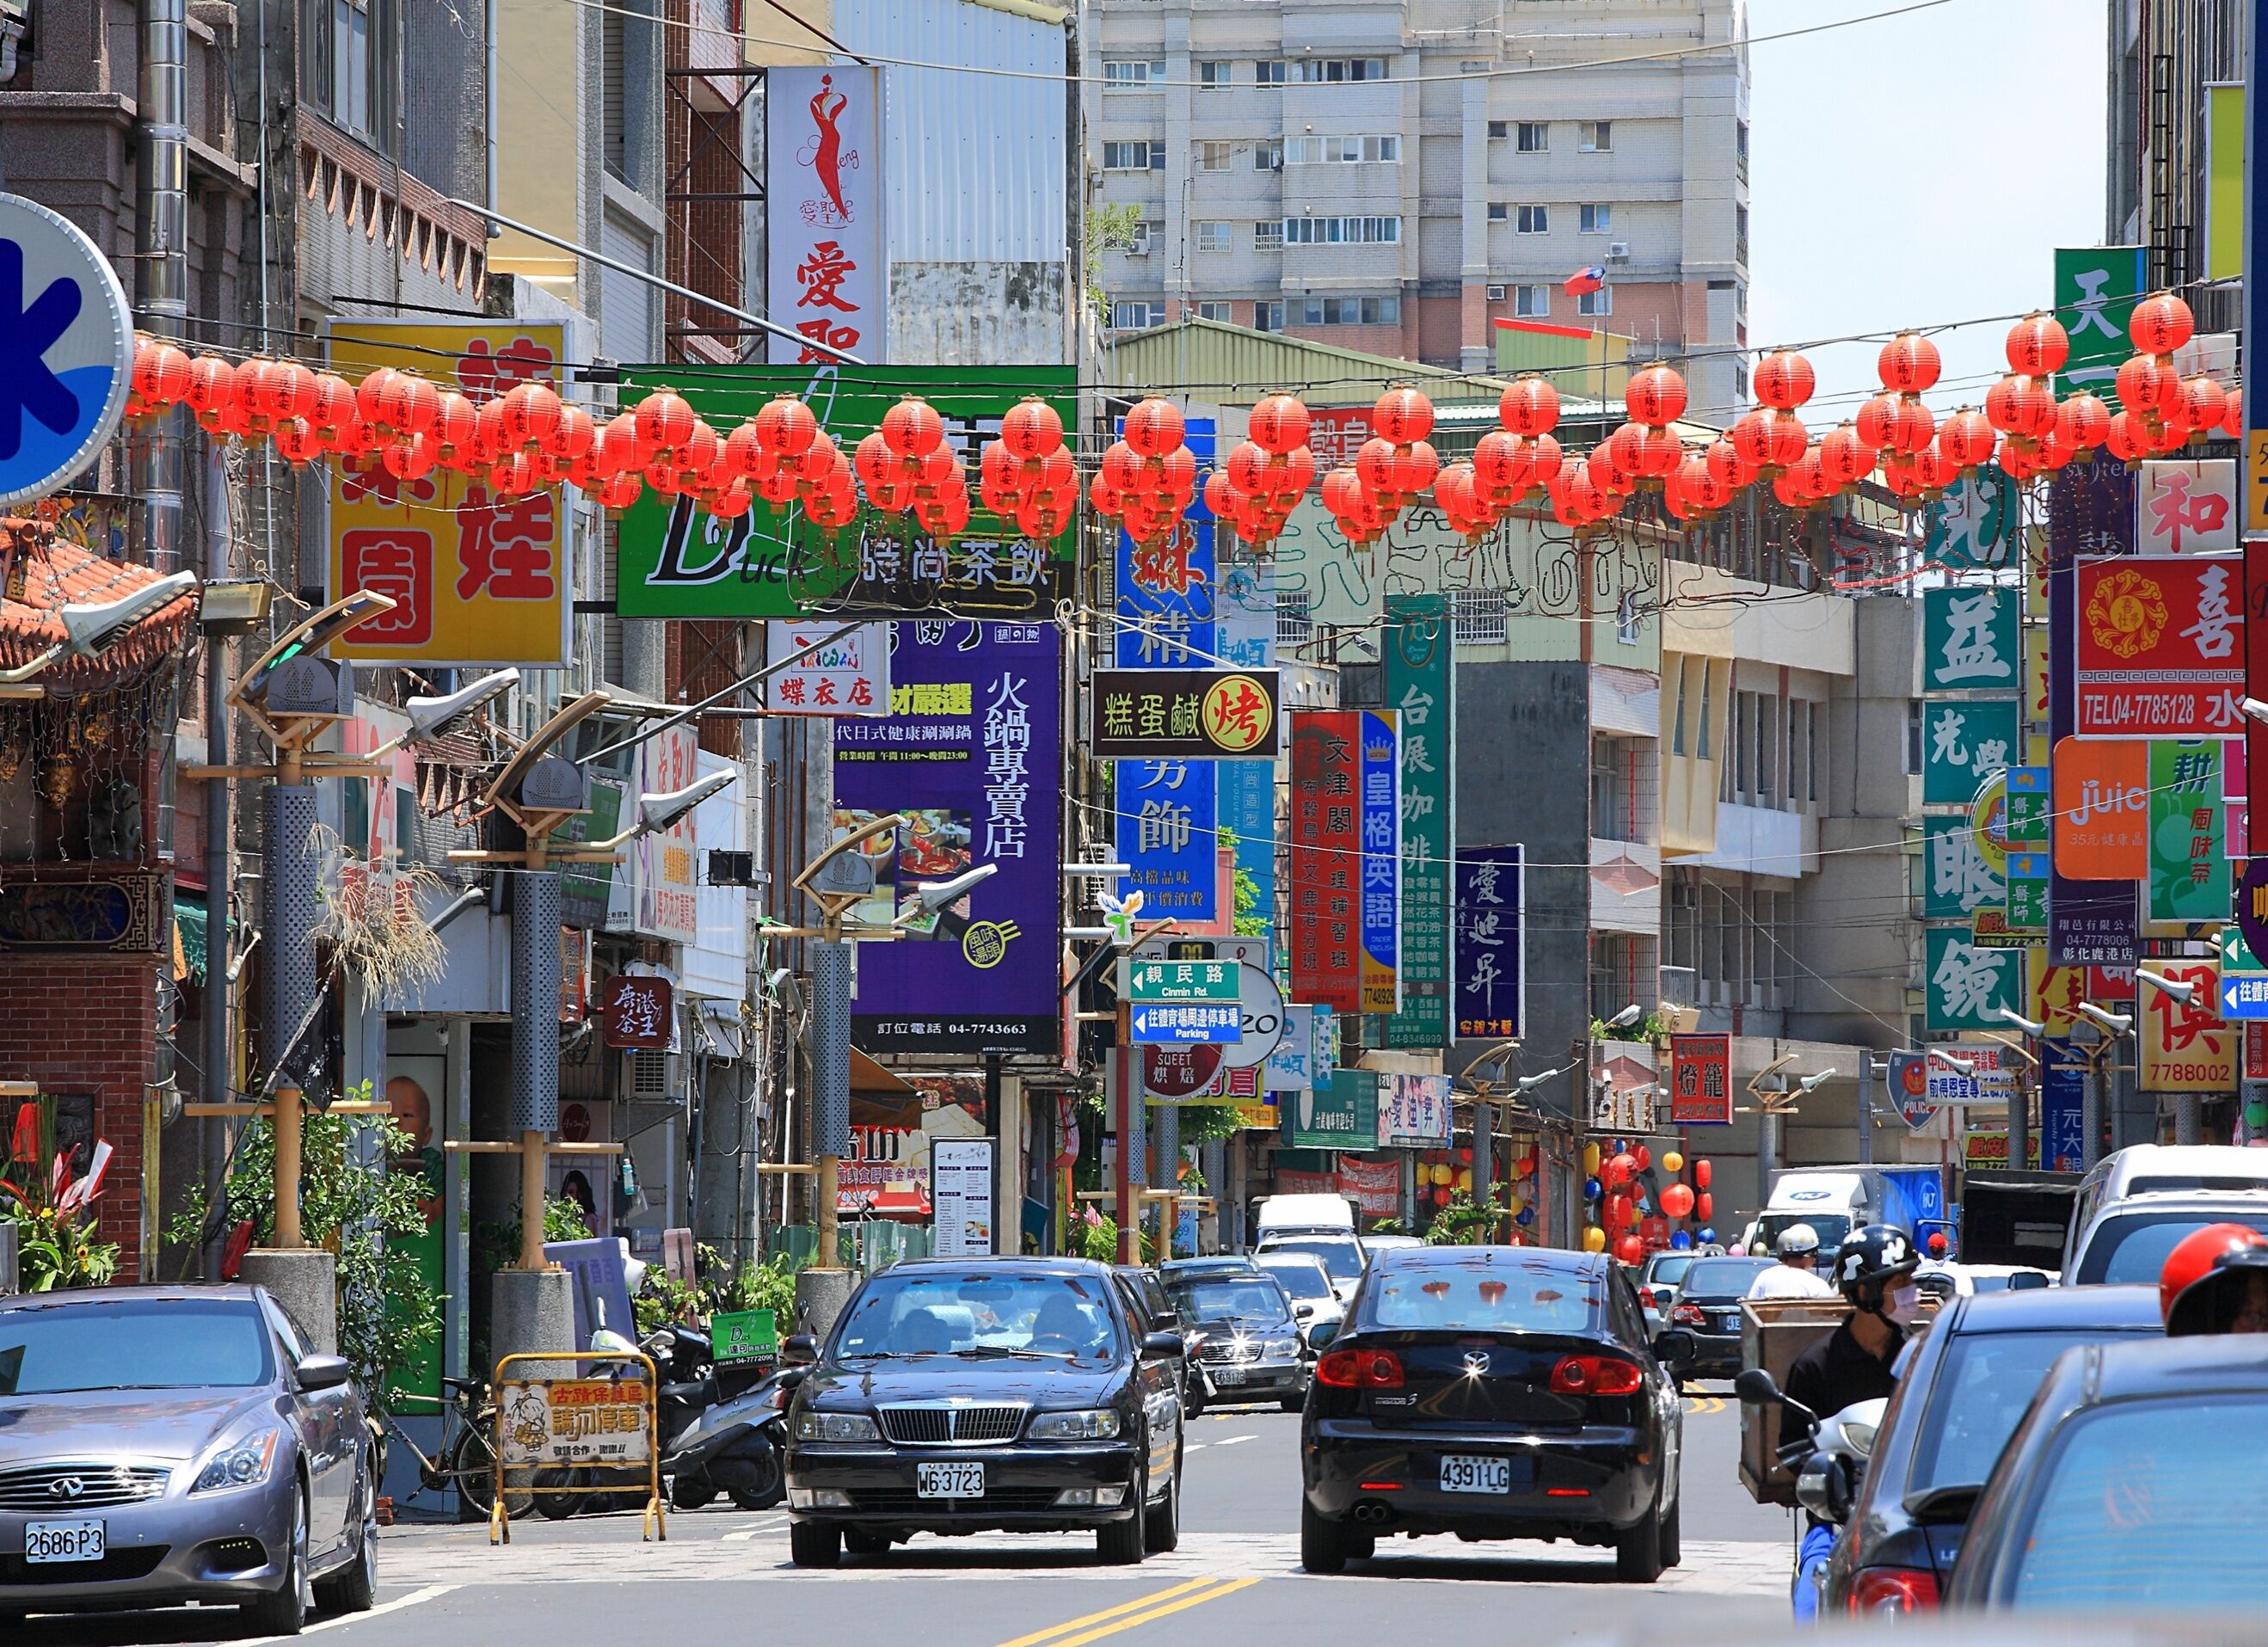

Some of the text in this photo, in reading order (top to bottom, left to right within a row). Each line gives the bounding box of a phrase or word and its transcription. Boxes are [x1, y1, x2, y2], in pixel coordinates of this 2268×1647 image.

[2149, 469, 2229, 554] 和
[995, 626, 1039, 642] 鍋の物
[778, 677, 874, 707] 蝶衣店
[1214, 684, 1263, 744] 烤
[982, 672, 1032, 858] 火鍋專賣店
[1364, 770, 1394, 930] 皇格英語
[2189, 808, 2214, 884] 風味茶
[2066, 934, 2130, 947] 04-7778006
[2062, 948, 2134, 962] 彰化鹿港店
[1145, 964, 1224, 984] 親民路
[1161, 986, 1208, 997] Cinmin Rd.
[1363, 987, 1395, 1005] 7748929
[1147, 1007, 1238, 1028] 往體育場周邊停車場
[876, 1023, 1027, 1036] 訂位電話 04-7743663
[1175, 1029, 1210, 1040] Parking
[1389, 1034, 1442, 1044] 04-8346999
[1158, 1053, 1193, 1066] SWEET
[1152, 1066, 1195, 1085] 烘焙
[1677, 1062, 1724, 1097] 燈籠
[2151, 1065, 2230, 1082] 7788002
[553, 1386, 644, 1404] 古蹟保護區
[551, 1406, 641, 1442] 請勿停車
